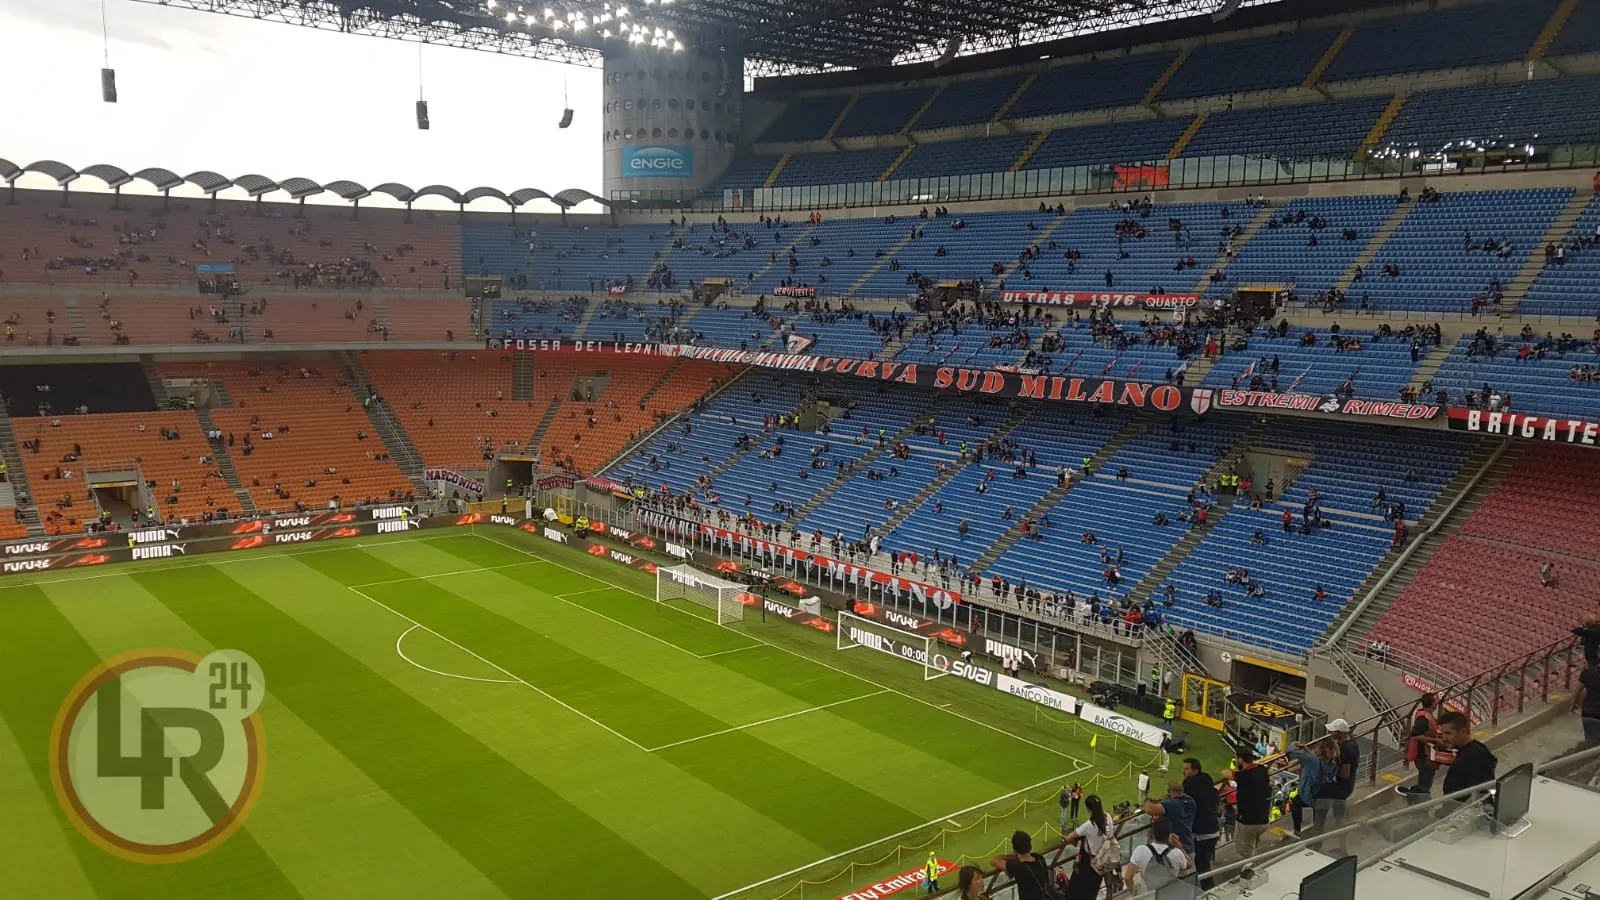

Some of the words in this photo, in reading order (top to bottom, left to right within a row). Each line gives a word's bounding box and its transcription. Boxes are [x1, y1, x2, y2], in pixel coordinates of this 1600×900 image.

[1003, 291, 1075, 306] ULTRAS
[1090, 293, 1137, 307] 1976
[1145, 296, 1196, 309] QUARTO
[503, 338, 560, 351] FOSSA
[574, 340, 602, 353] DEI
[614, 341, 658, 355] LEONI
[820, 357, 917, 384] CURVA
[934, 367, 1005, 394] SUD
[1019, 374, 1182, 411] MILANO
[1220, 389, 1321, 411] ESTREMI
[1342, 399, 1440, 420] RIMEDI
[1467, 410, 1598, 444] BRIGATE
[372, 506, 404, 520] PUMA
[128, 530, 167, 543] PUMA
[377, 520, 409, 534] PUMA
[544, 527, 562, 543] PUMA
[132, 545, 172, 560] PUMA
[665, 542, 686, 559] PUMA
[672, 568, 696, 588] PUMA
[825, 559, 953, 611] MILANO
[850, 626, 882, 649] PUMA
[901, 644, 926, 663] 00:00
[985, 638, 1023, 663] PUMA
[1009, 684, 1042, 703] BANCO
[1043, 695, 1062, 710] BPM
[1094, 714, 1125, 734] BANCO
[1125, 725, 1144, 742] BPM
